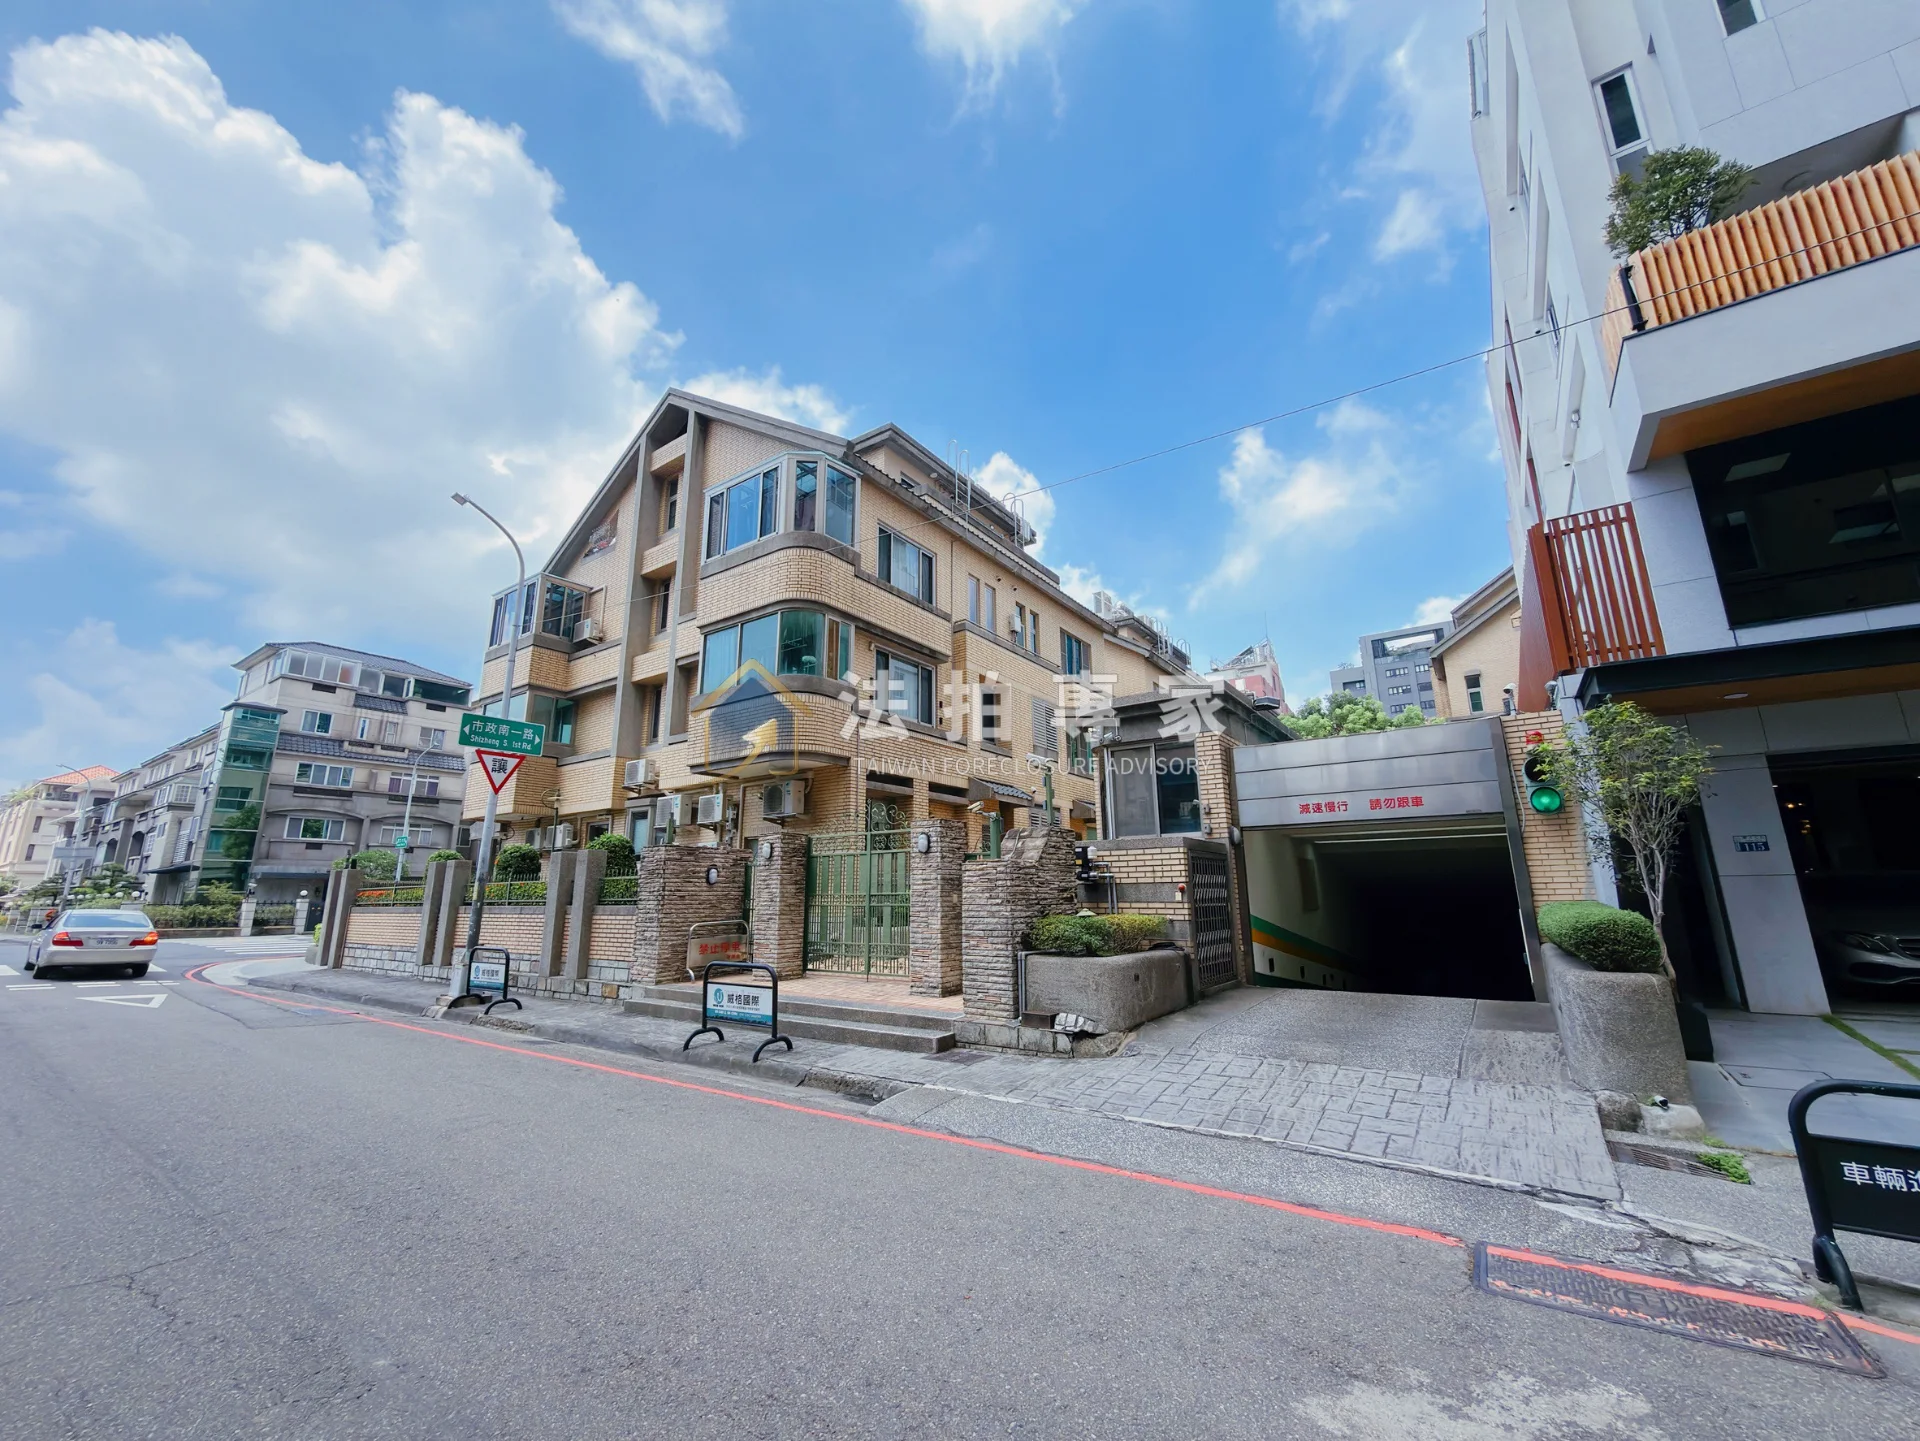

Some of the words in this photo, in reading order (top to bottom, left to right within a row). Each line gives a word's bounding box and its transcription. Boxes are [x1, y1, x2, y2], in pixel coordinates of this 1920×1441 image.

[472, 720, 534, 740] 市政南一路
[470, 734, 500, 748] Shizheng
[512, 741, 521, 749] 1st
[491, 758, 508, 774] 讓
[1299, 801, 1348, 814] 減速慢行
[1369, 795, 1425, 811] 請勿跟車
[1744, 843, 1765, 851] 115
